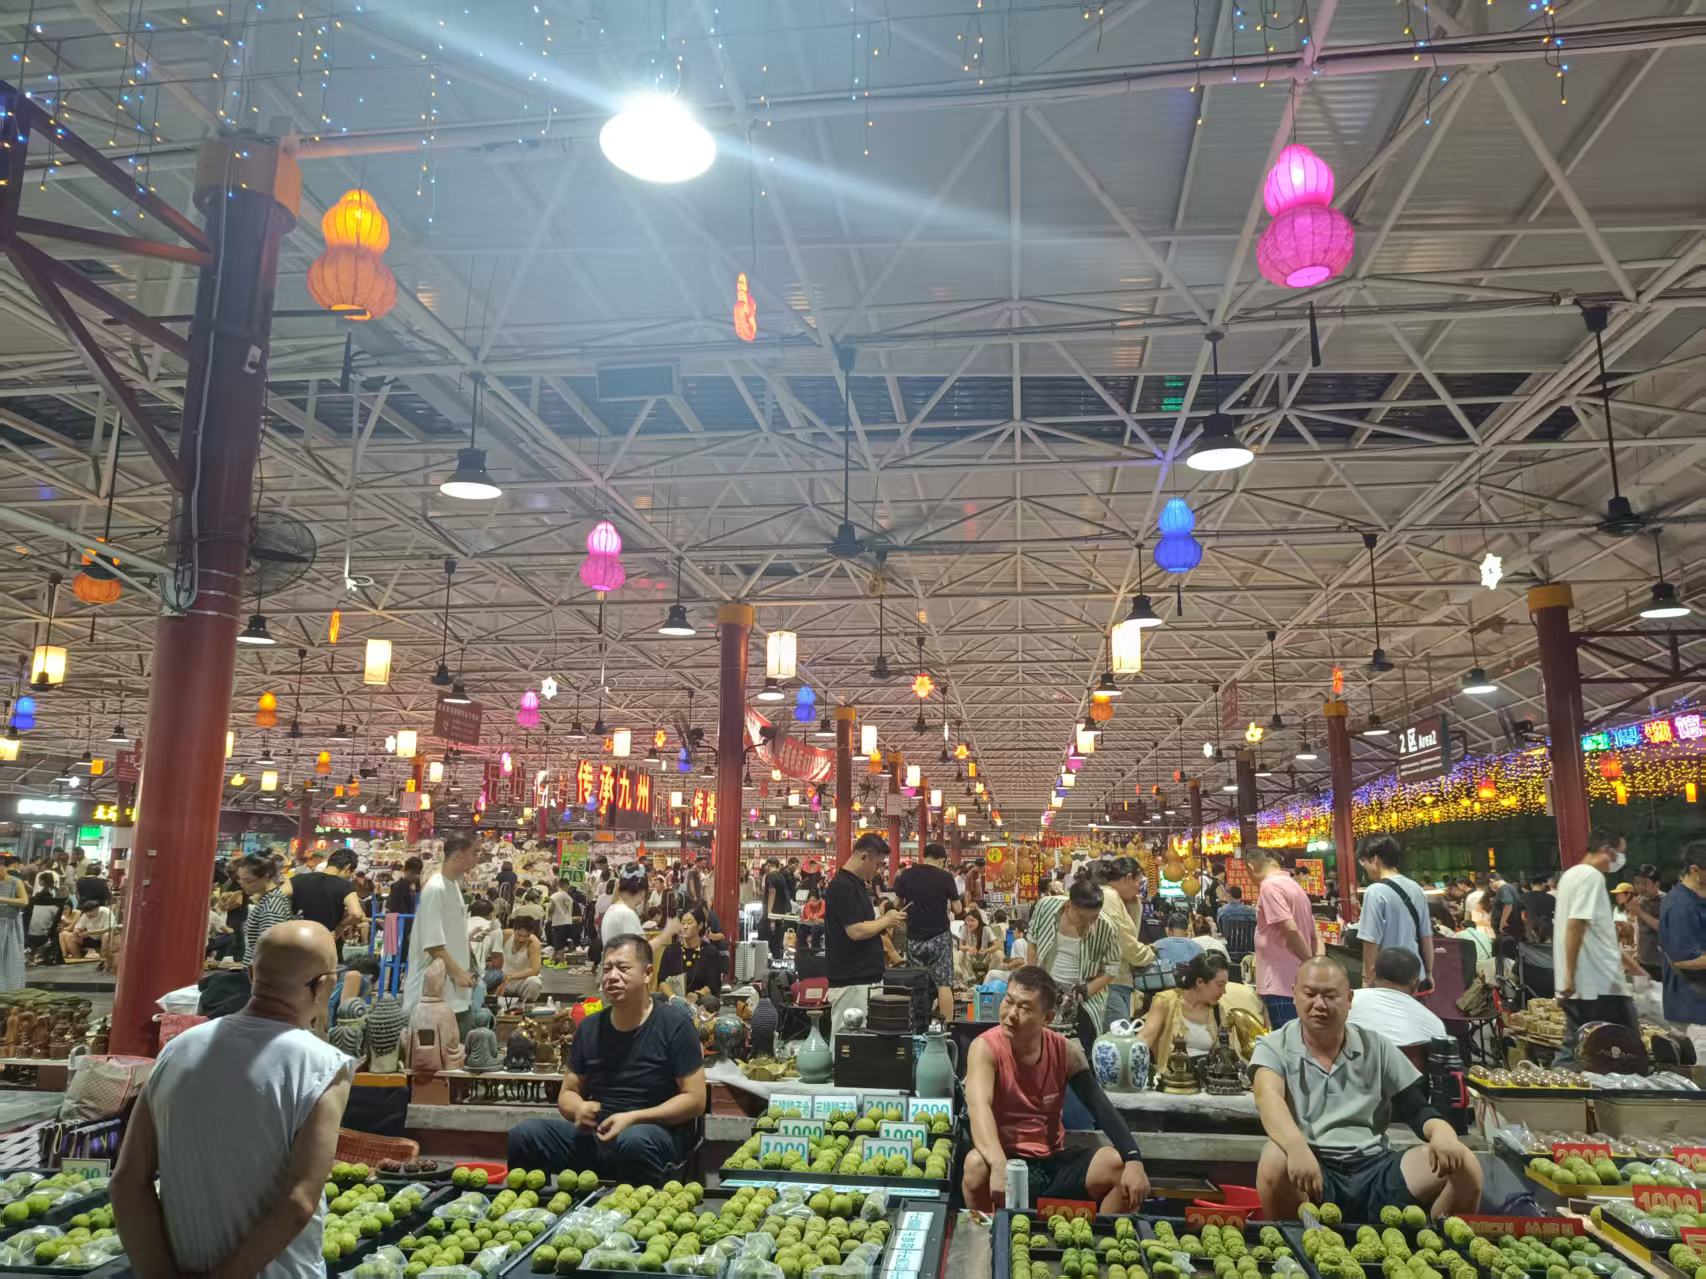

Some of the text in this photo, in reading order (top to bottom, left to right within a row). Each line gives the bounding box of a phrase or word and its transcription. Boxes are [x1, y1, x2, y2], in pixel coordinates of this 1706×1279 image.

[577, 759, 649, 814] 传承九州
[782, 1124, 823, 1142] 1000
[884, 1128, 924, 1147] 1000
[763, 1140, 805, 1160] 1000
[865, 1145, 908, 1163] 1000
[1638, 1191, 1697, 1214] 1000
